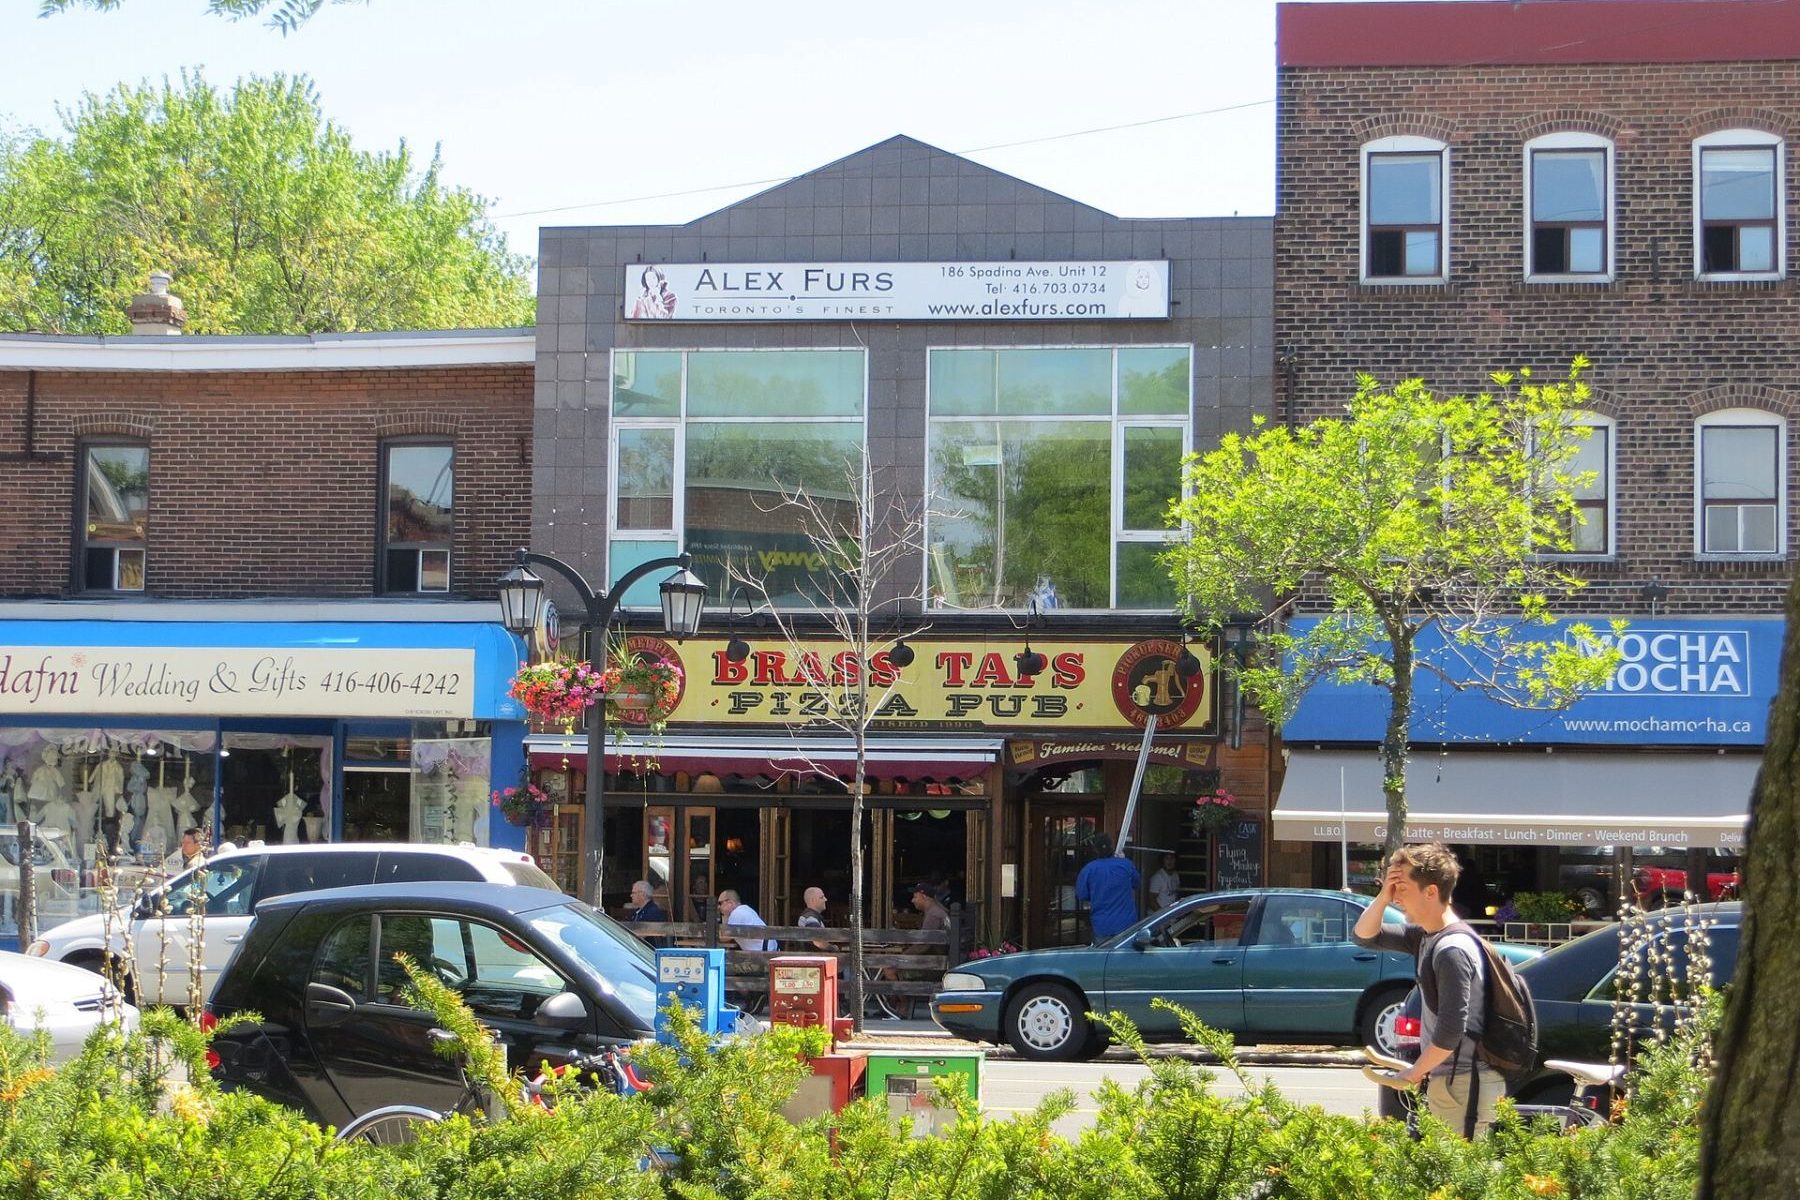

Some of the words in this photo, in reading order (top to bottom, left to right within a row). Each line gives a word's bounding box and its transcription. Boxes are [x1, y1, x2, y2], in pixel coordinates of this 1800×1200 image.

[694, 268, 784, 291] ALEX
[804, 268, 894, 292] FURS
[941, 267, 963, 278] 186
[969, 266, 1021, 280] Spadina
[1026, 267, 1053, 277] Ave.
[1059, 266, 1086, 277] Unit
[1092, 266, 1107, 277] 12
[1012, 283, 1106, 294] 416.703.0734
[693, 305, 804, 314] TORONTO'S
[823, 305, 894, 314] FINEST
[928, 299, 1106, 316] www.alexfurs.com
[711, 650, 902, 688] BRASS
[1576, 663, 1741, 692] OCHA
[92, 661, 200, 703] Wedding
[209, 661, 240, 694] &
[248, 656, 307, 699] Gifts
[320, 671, 460, 696] 416-406-4242
[728, 691, 918, 717] PIZZA
[945, 693, 1068, 718] PUB
[1040, 742, 1105, 759] Families
[1111, 742, 1182, 758] Welome!
[1406, 827, 1433, 839] Latte
[1443, 827, 1494, 840] Breakfast
[1504, 828, 1537, 841] Lunch
[1546, 828, 1583, 841] Dinner
[1595, 829, 1645, 842] Weekend
[1649, 830, 1688, 842] Brunch
